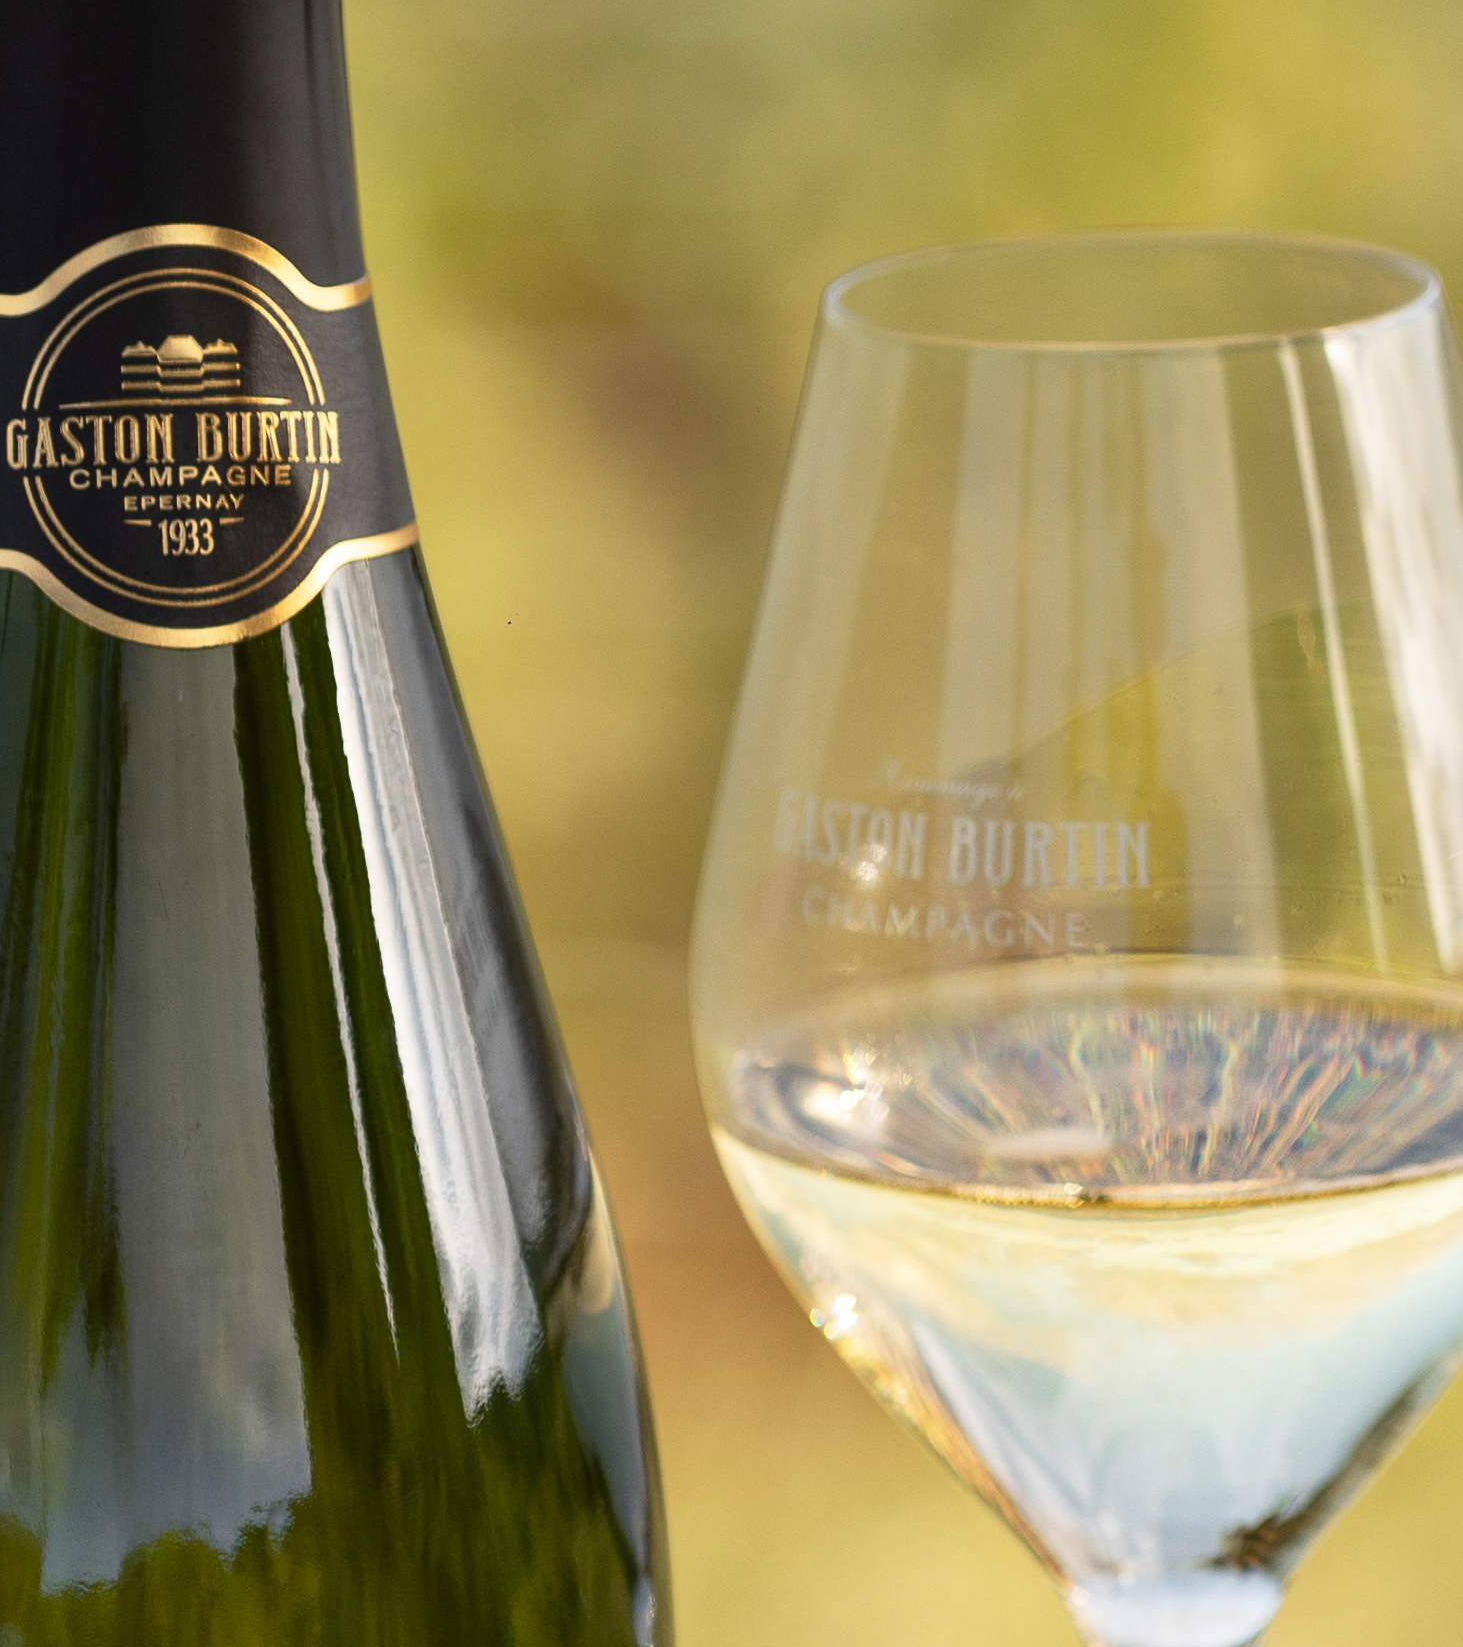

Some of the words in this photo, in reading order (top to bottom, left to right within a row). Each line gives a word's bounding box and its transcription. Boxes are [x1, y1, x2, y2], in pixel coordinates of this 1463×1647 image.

[6, 412, 174, 470] GASTON
[196, 410, 341, 464] BURTIN
[69, 464, 292, 490] CHAMPAGNE
[124, 493, 245, 512] EPERNAY
[158, 517, 215, 556] 1933
[948, 815, 1151, 890] BURTIN
